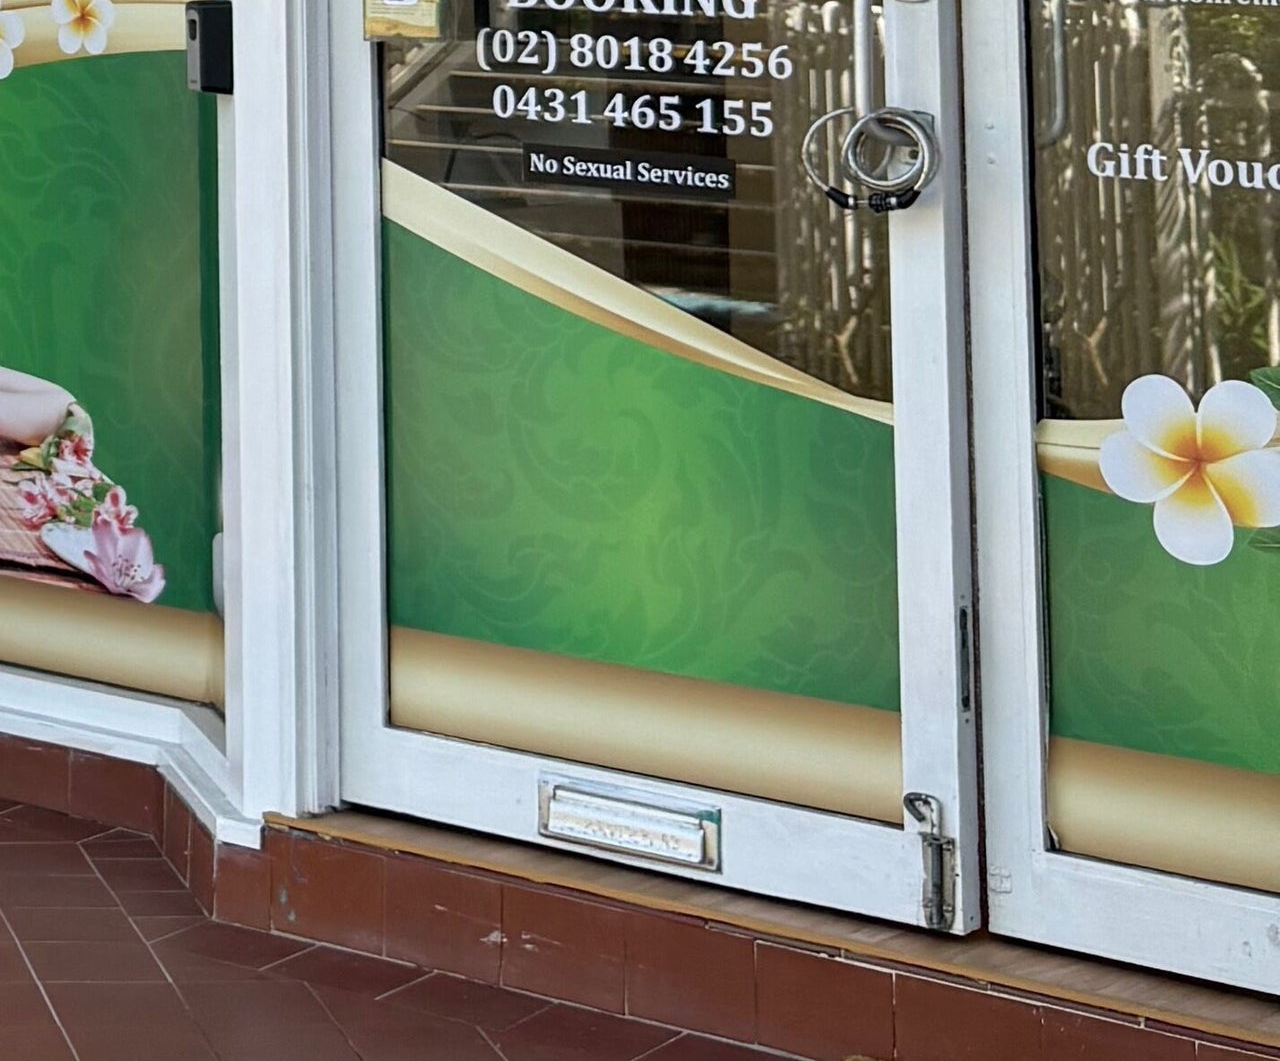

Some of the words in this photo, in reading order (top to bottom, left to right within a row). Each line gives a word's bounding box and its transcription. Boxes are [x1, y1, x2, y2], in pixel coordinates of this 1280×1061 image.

[476, 27, 558, 74] (02)
[570, 31, 676, 74] 8018
[684, 39, 793, 81] 4256
[492, 85, 592, 126] 0431
[604, 89, 681, 132] 465
[697, 97, 774, 138] 155
[529, 153, 558, 176] No
[563, 154, 632, 183] Sexual
[637, 163, 730, 190] Services
[1087, 142, 1168, 181] Gift
